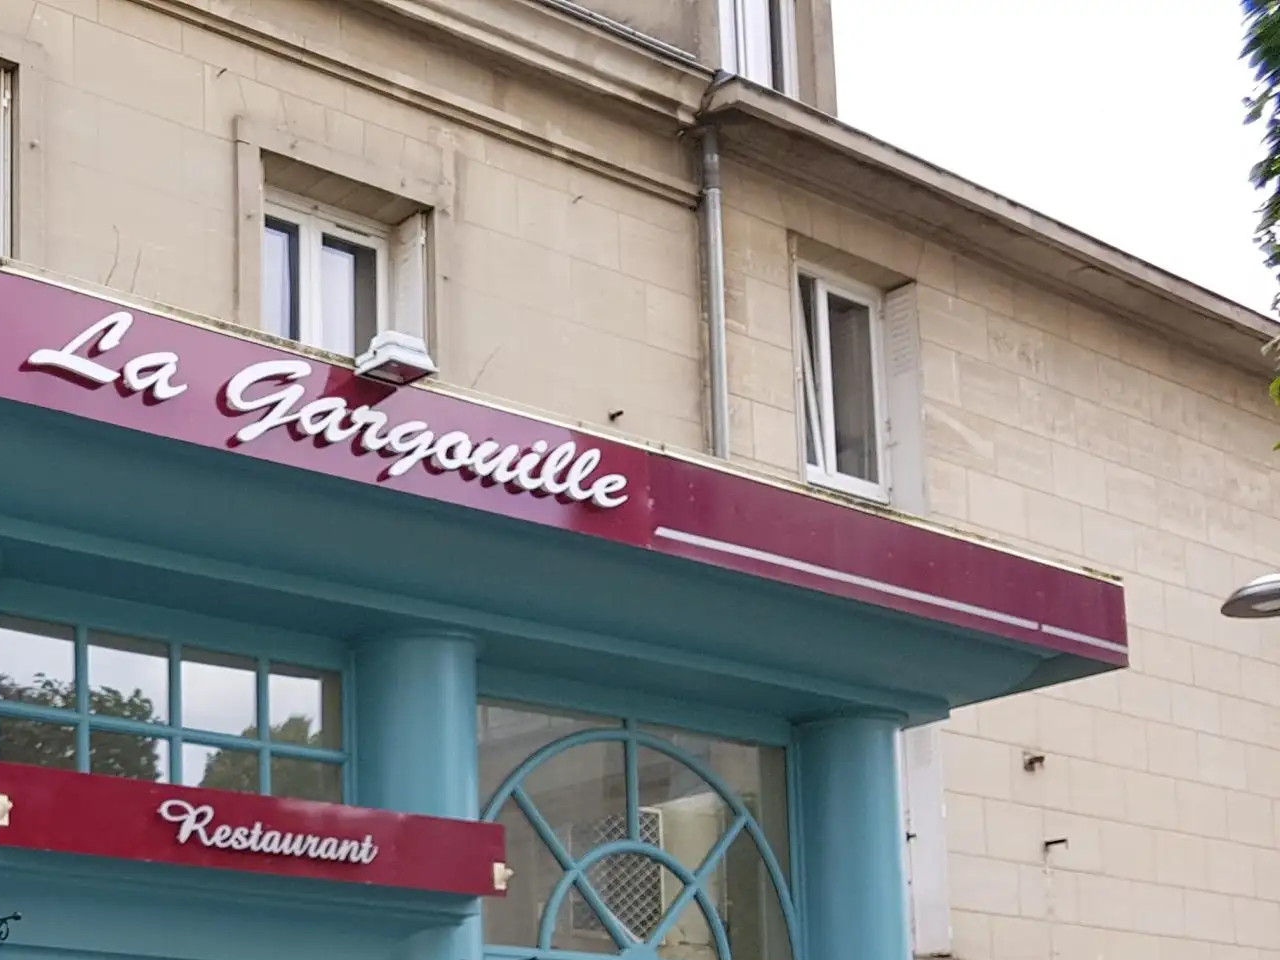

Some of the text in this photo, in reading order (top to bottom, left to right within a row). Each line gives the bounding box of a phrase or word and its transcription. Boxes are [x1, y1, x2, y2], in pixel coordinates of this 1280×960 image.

[27, 310, 629, 508] La Gargouille
[157, 799, 379, 865] Restaurant
